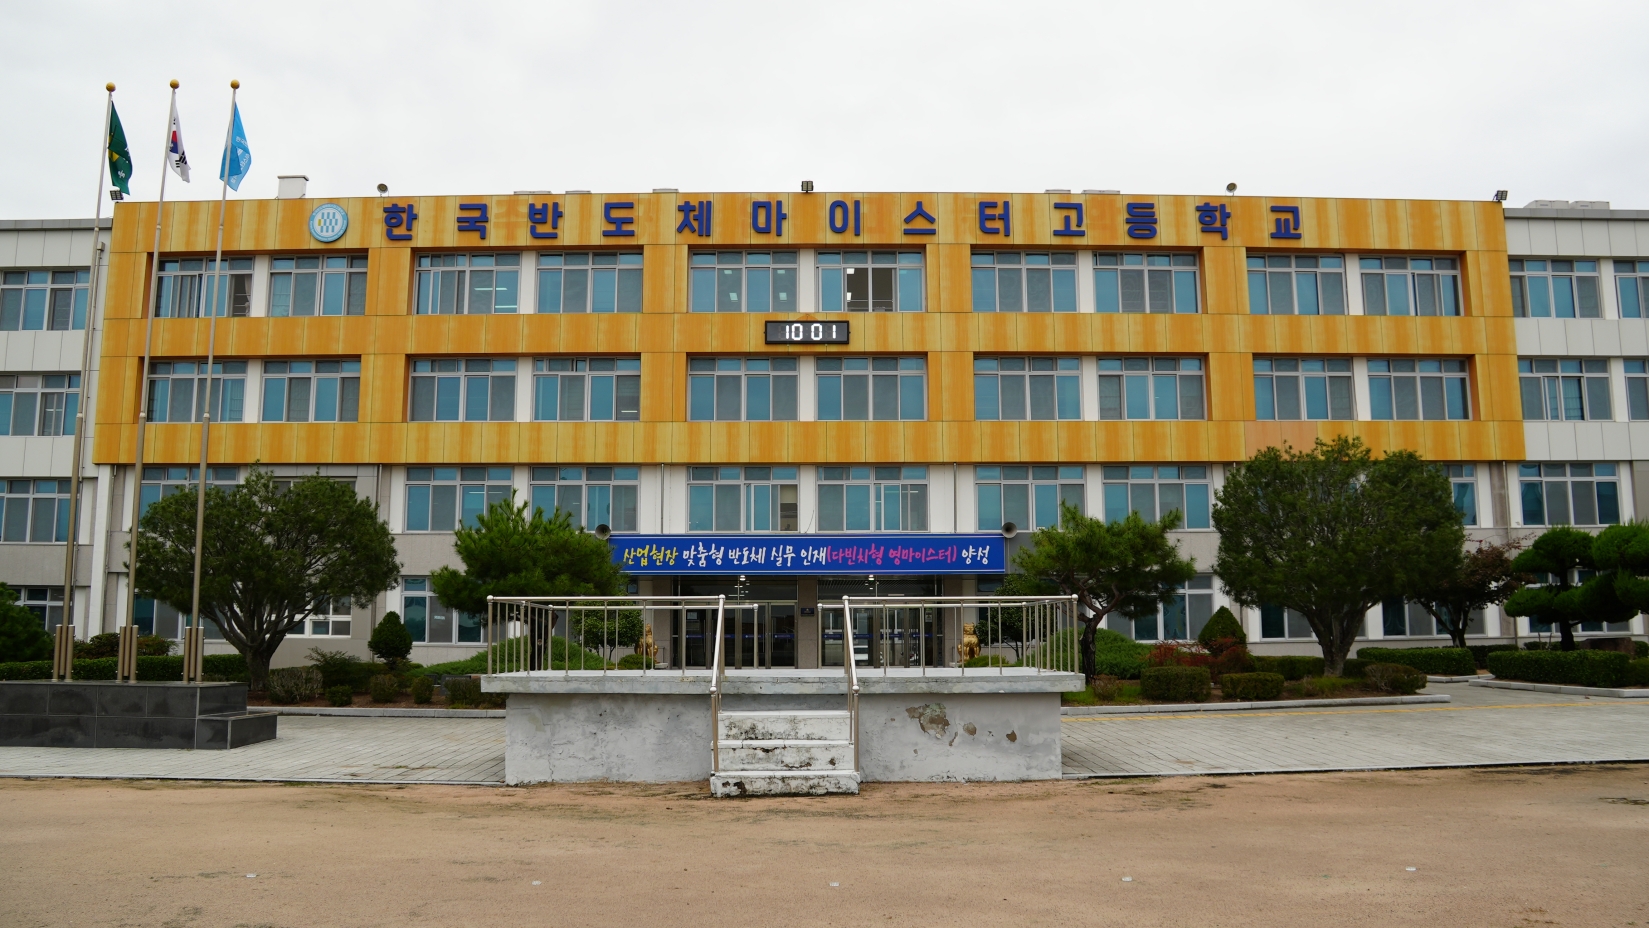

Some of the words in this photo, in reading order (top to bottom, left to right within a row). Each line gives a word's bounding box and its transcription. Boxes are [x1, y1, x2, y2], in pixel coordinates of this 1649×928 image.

[622, 544, 678, 567] 산업현장
[682, 541, 725, 567] 맞춤형
[728, 545, 766, 565] 반도체
[770, 544, 796, 567] 실무
[888, 545, 957, 565] 영마이스터)
[961, 545, 990, 565] 양성
